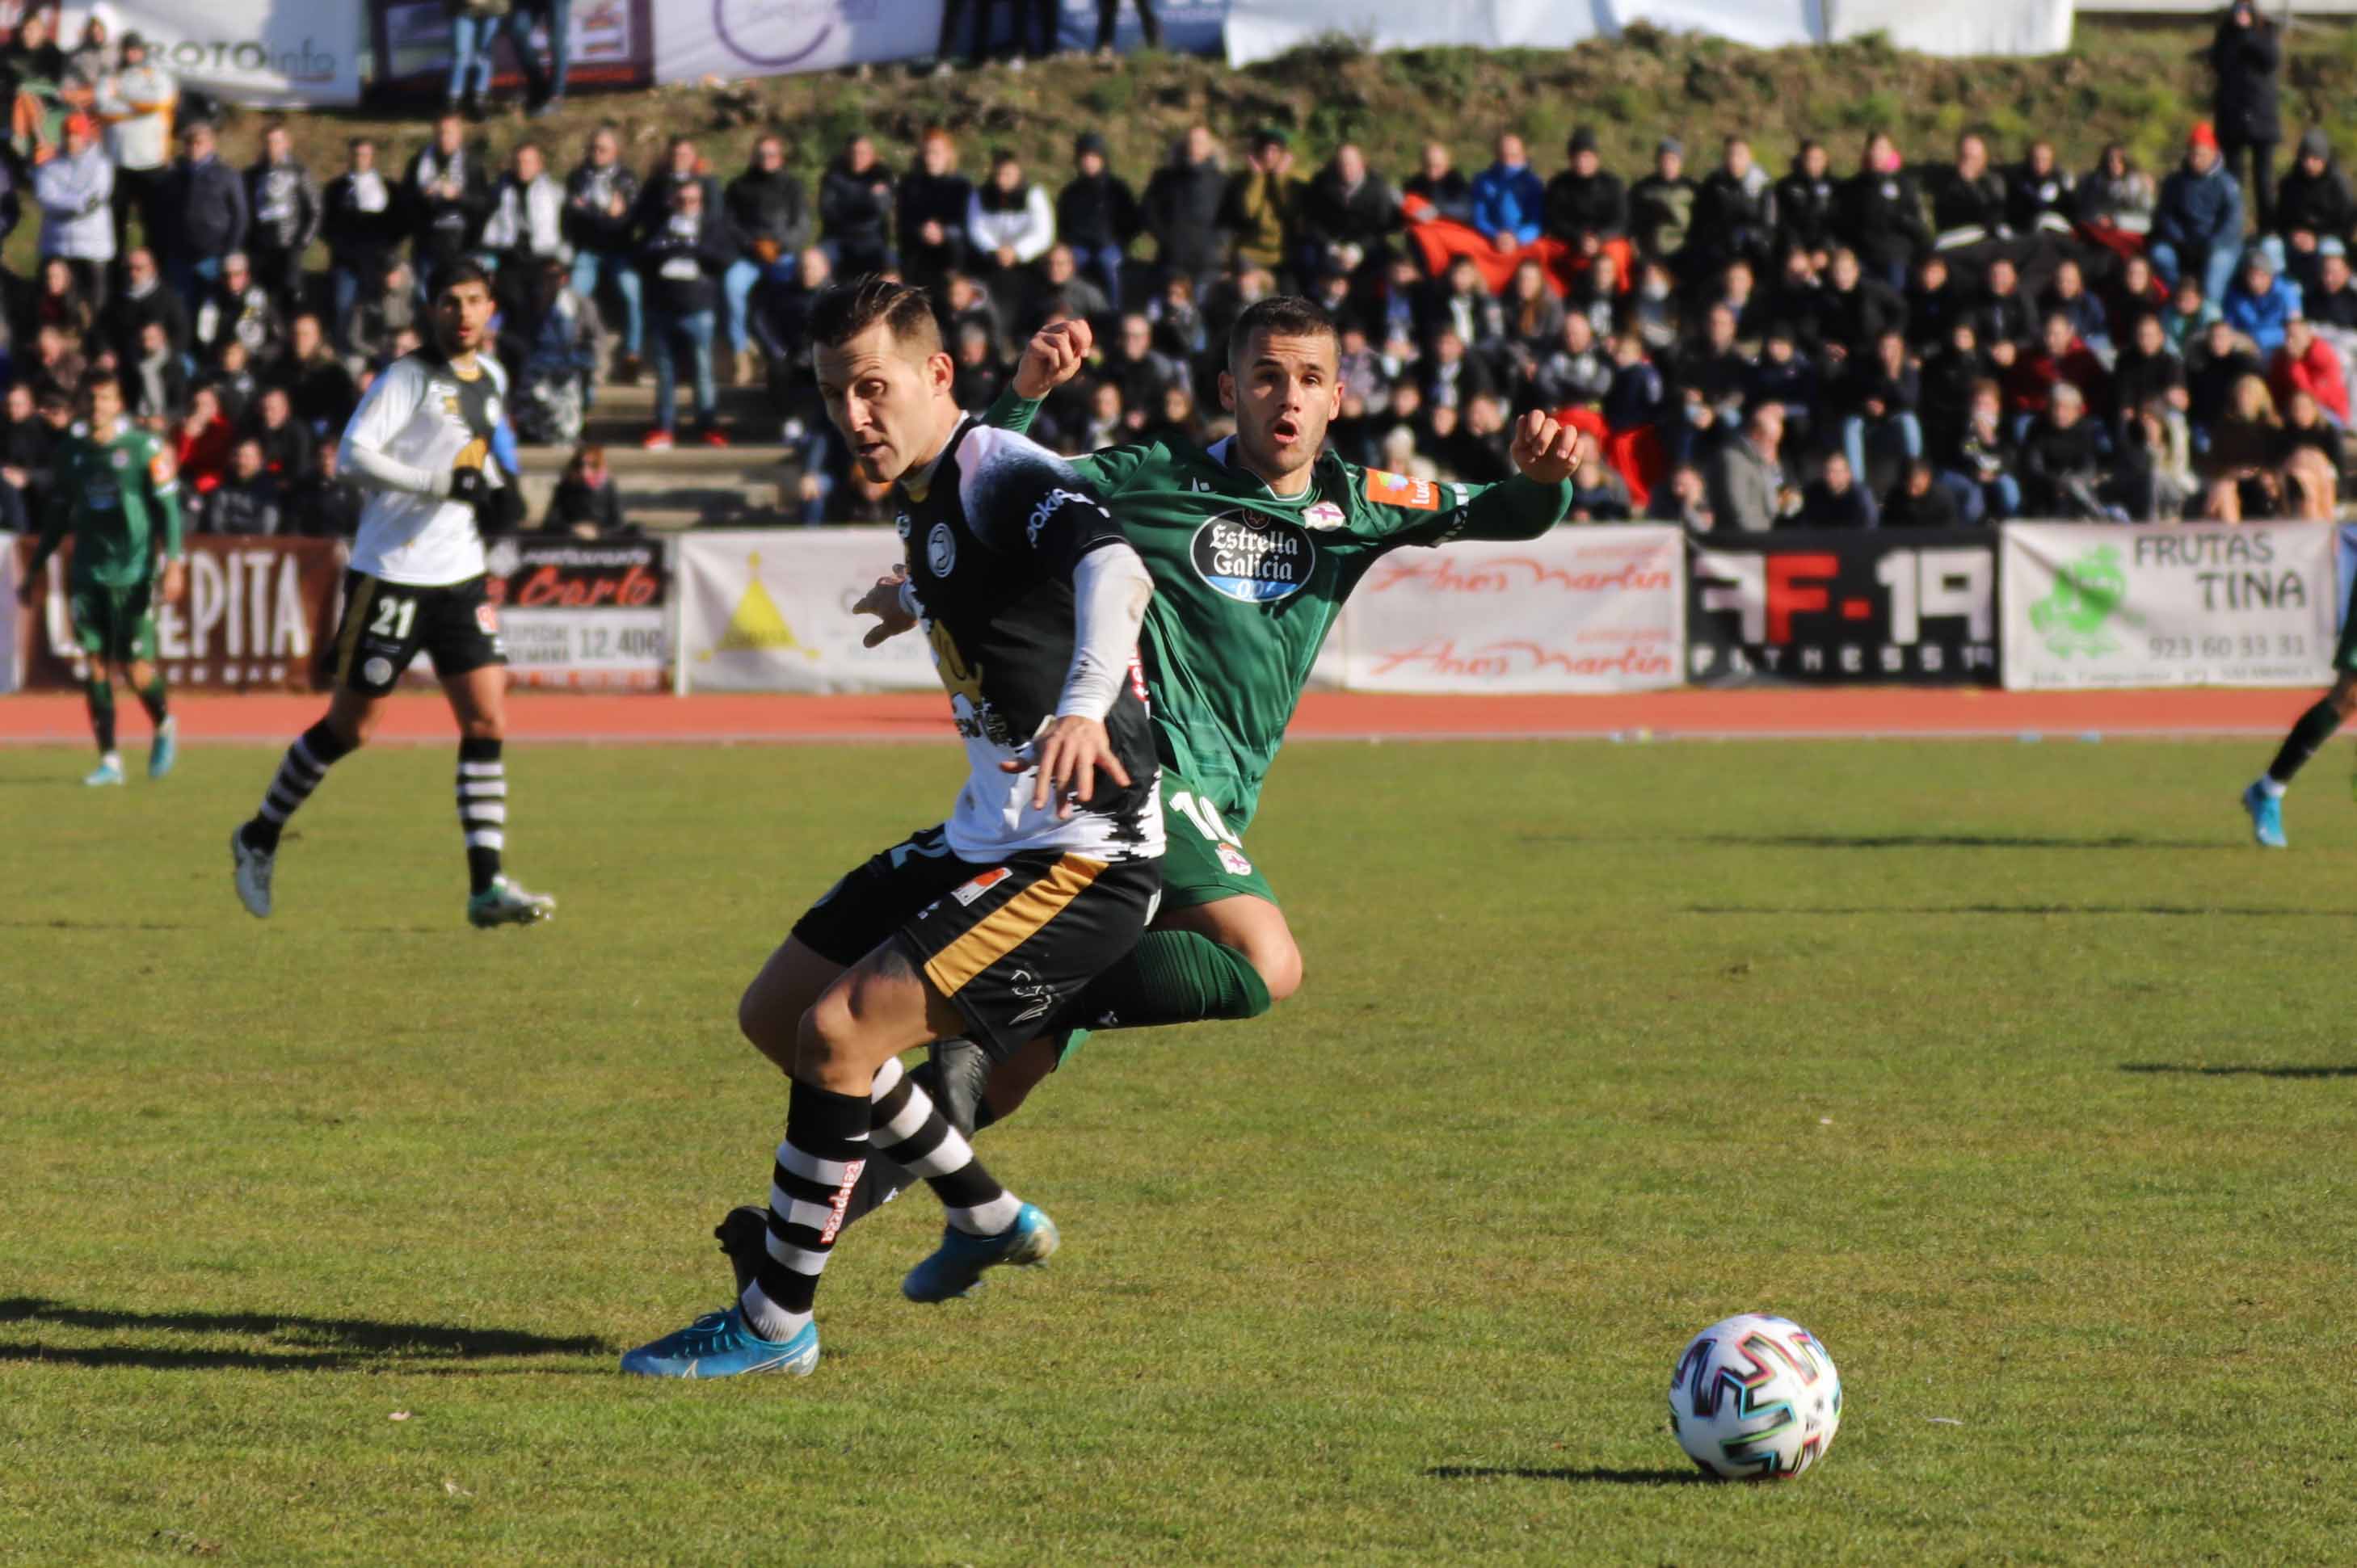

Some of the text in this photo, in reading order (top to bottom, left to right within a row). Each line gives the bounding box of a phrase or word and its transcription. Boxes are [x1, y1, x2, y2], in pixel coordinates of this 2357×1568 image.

[1210, 524, 1298, 555] Estrella
[2134, 532, 2275, 567] FRUTAS
[1214, 550, 1292, 580] Galicia
[154, 549, 310, 658] EPITA
[2195, 570, 2306, 611] TINA
[370, 596, 416, 638] 21
[2149, 636, 2191, 659] 923
[2202, 637, 2232, 658] 60
